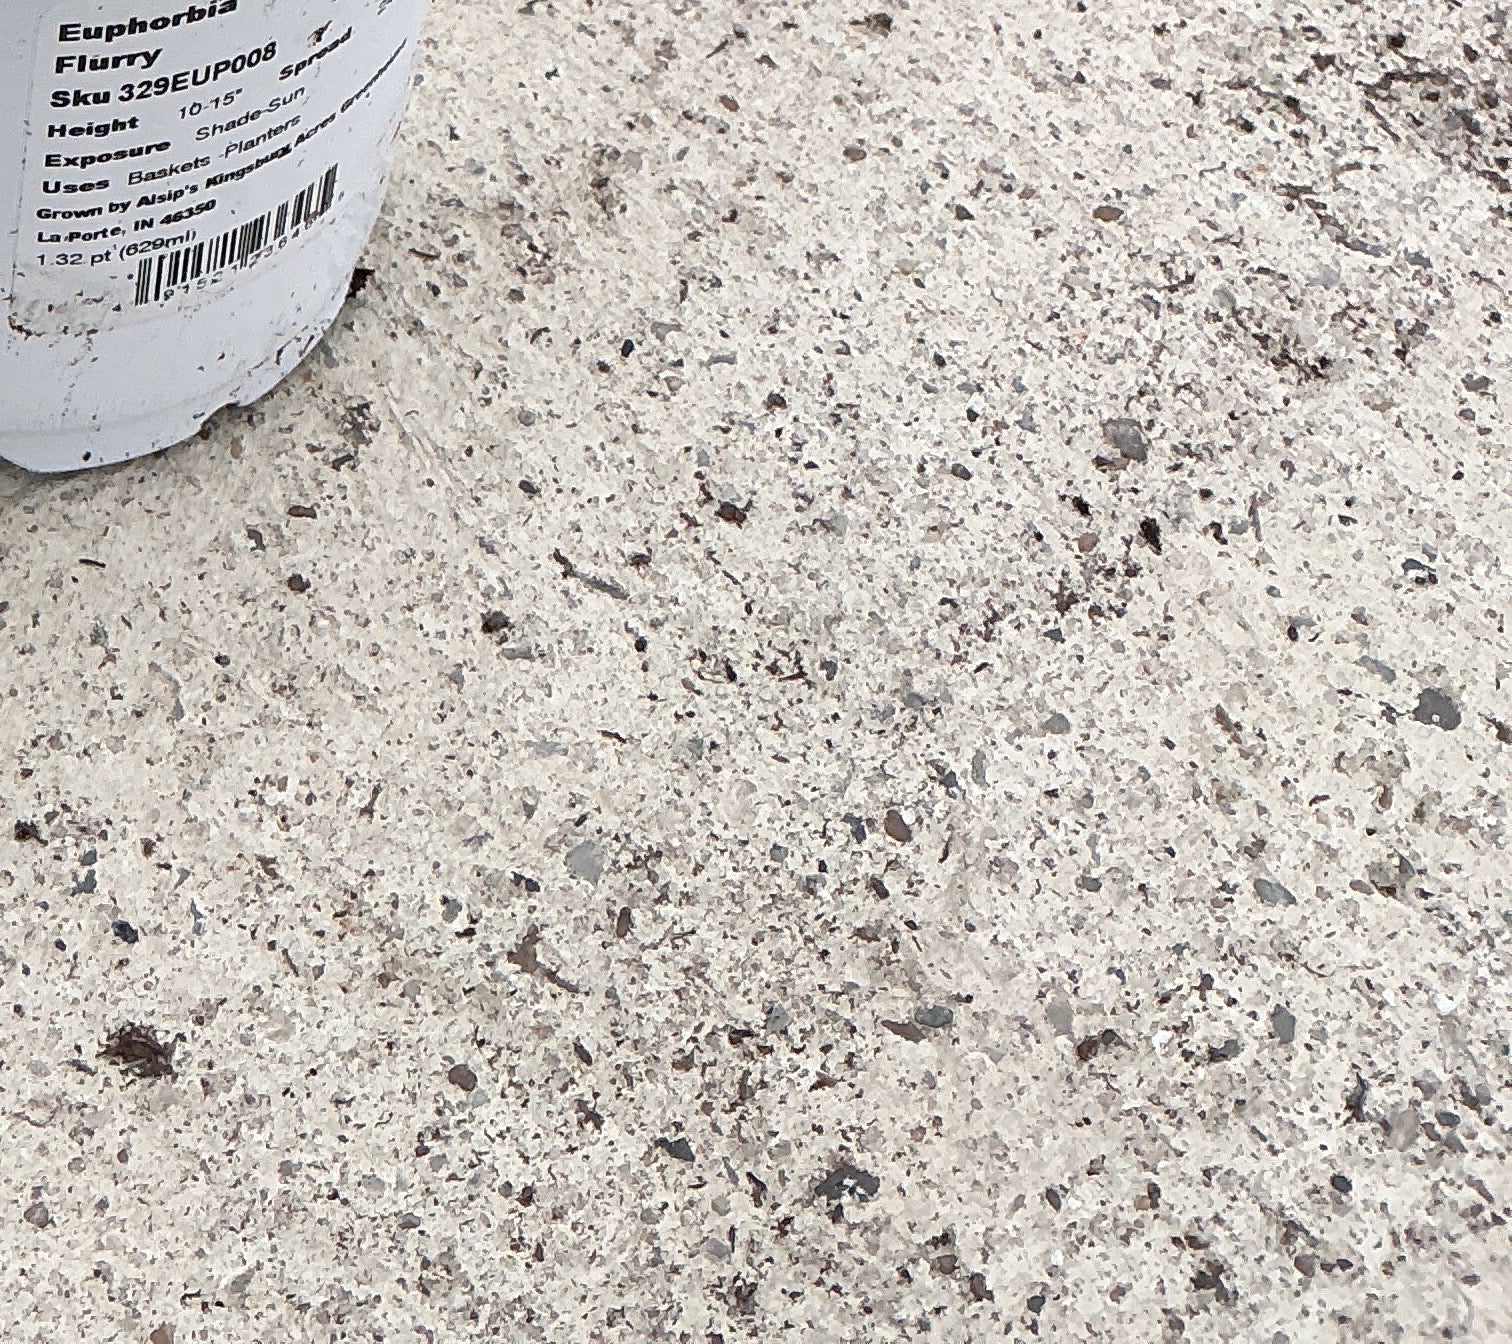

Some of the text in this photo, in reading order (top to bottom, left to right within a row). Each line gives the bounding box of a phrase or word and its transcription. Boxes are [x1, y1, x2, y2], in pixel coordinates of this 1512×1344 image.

[47, 116, 140, 139] Height
[278, 25, 353, 81] Spread
[49, 40, 278, 109] Sku 329EUP008
[54, 47, 164, 75] Flurry
[44, 86, 306, 169] Exposure Shade-Sun
[35, 205, 104, 220] Grown
[108, 200, 132, 214] by
[136, 184, 199, 208] Alsip's
[204, 142, 293, 189] Kingsbury
[294, 111, 337, 148] Acres
[42, 179, 111, 194] Uses
[127, 155, 211, 186] Baskets
[36, 228, 197, 267] 1.32 pt (629ml)
[37, 231, 61, 243] La
[133, 217, 155, 232] IN
[159, 198, 217, 225] 46350
